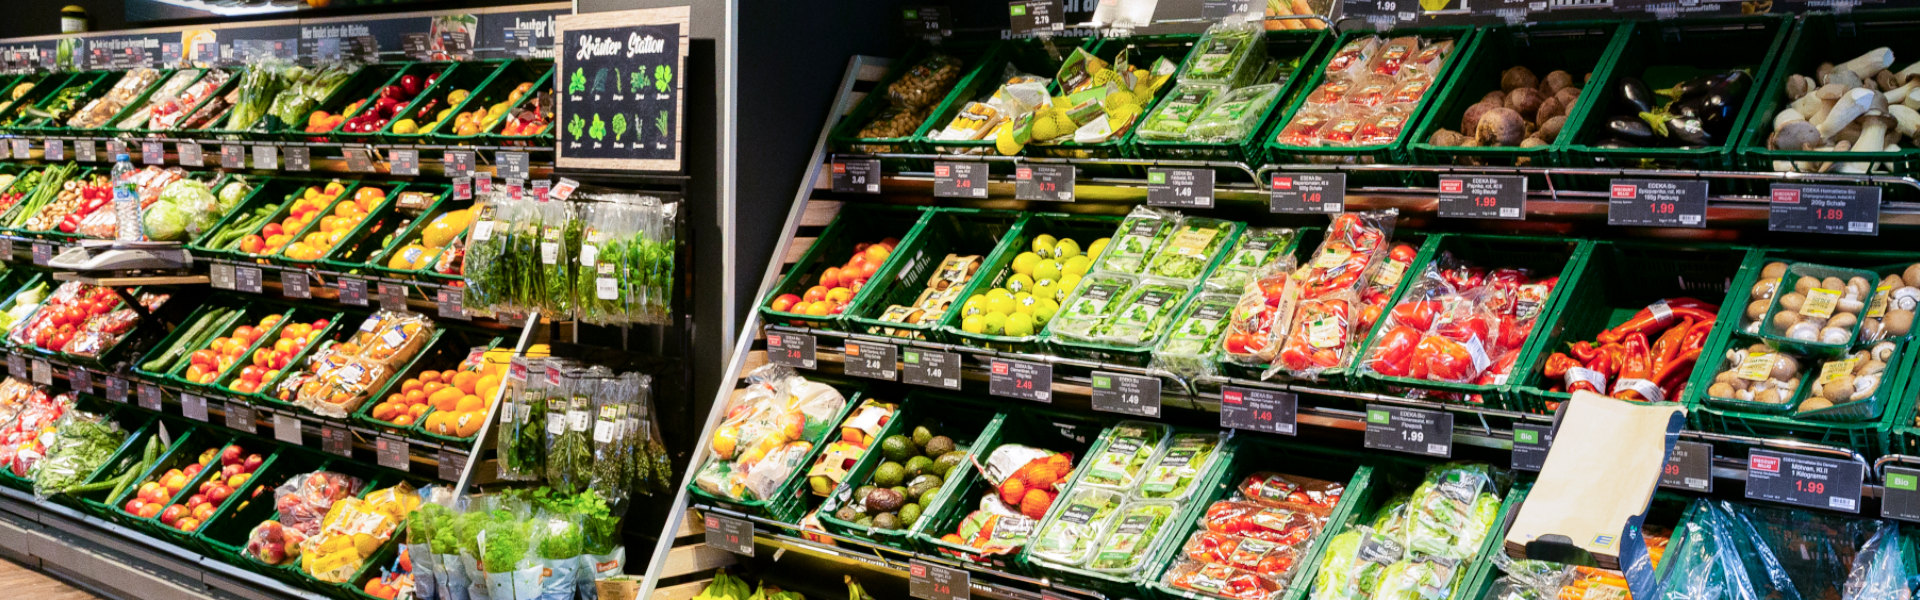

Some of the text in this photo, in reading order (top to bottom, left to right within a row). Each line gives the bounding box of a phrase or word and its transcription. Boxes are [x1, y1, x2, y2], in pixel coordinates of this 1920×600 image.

[1231, 3, 1249, 13] 1.49
[1377, 1, 1396, 11] 1.99
[1034, 16, 1050, 25] 2.79
[576, 31, 665, 61] Kräuter Station
[852, 176, 865, 184] 3.49
[1040, 182, 1055, 191] 0.79
[1175, 187, 1192, 197] 1.49
[1302, 192, 1321, 202] 1.49
[1475, 196, 1496, 207] 1.99
[1650, 203, 1674, 214] 1.99
[1816, 209, 1843, 220] 1.89
[866, 360, 880, 369] 2.49
[927, 368, 942, 377] 1.49
[1016, 379, 1032, 389] 2.49
[1122, 394, 1139, 405] 1.49
[1253, 410, 1272, 421] 1.49
[1373, 413, 1384, 421] Bio
[1401, 430, 1424, 442] 1.99
[1521, 432, 1532, 440] Bio
[1665, 464, 1679, 475] 99
[1894, 477, 1909, 486] Bio
[1796, 480, 1824, 494] 1.99
[934, 583, 950, 594] 2.49
